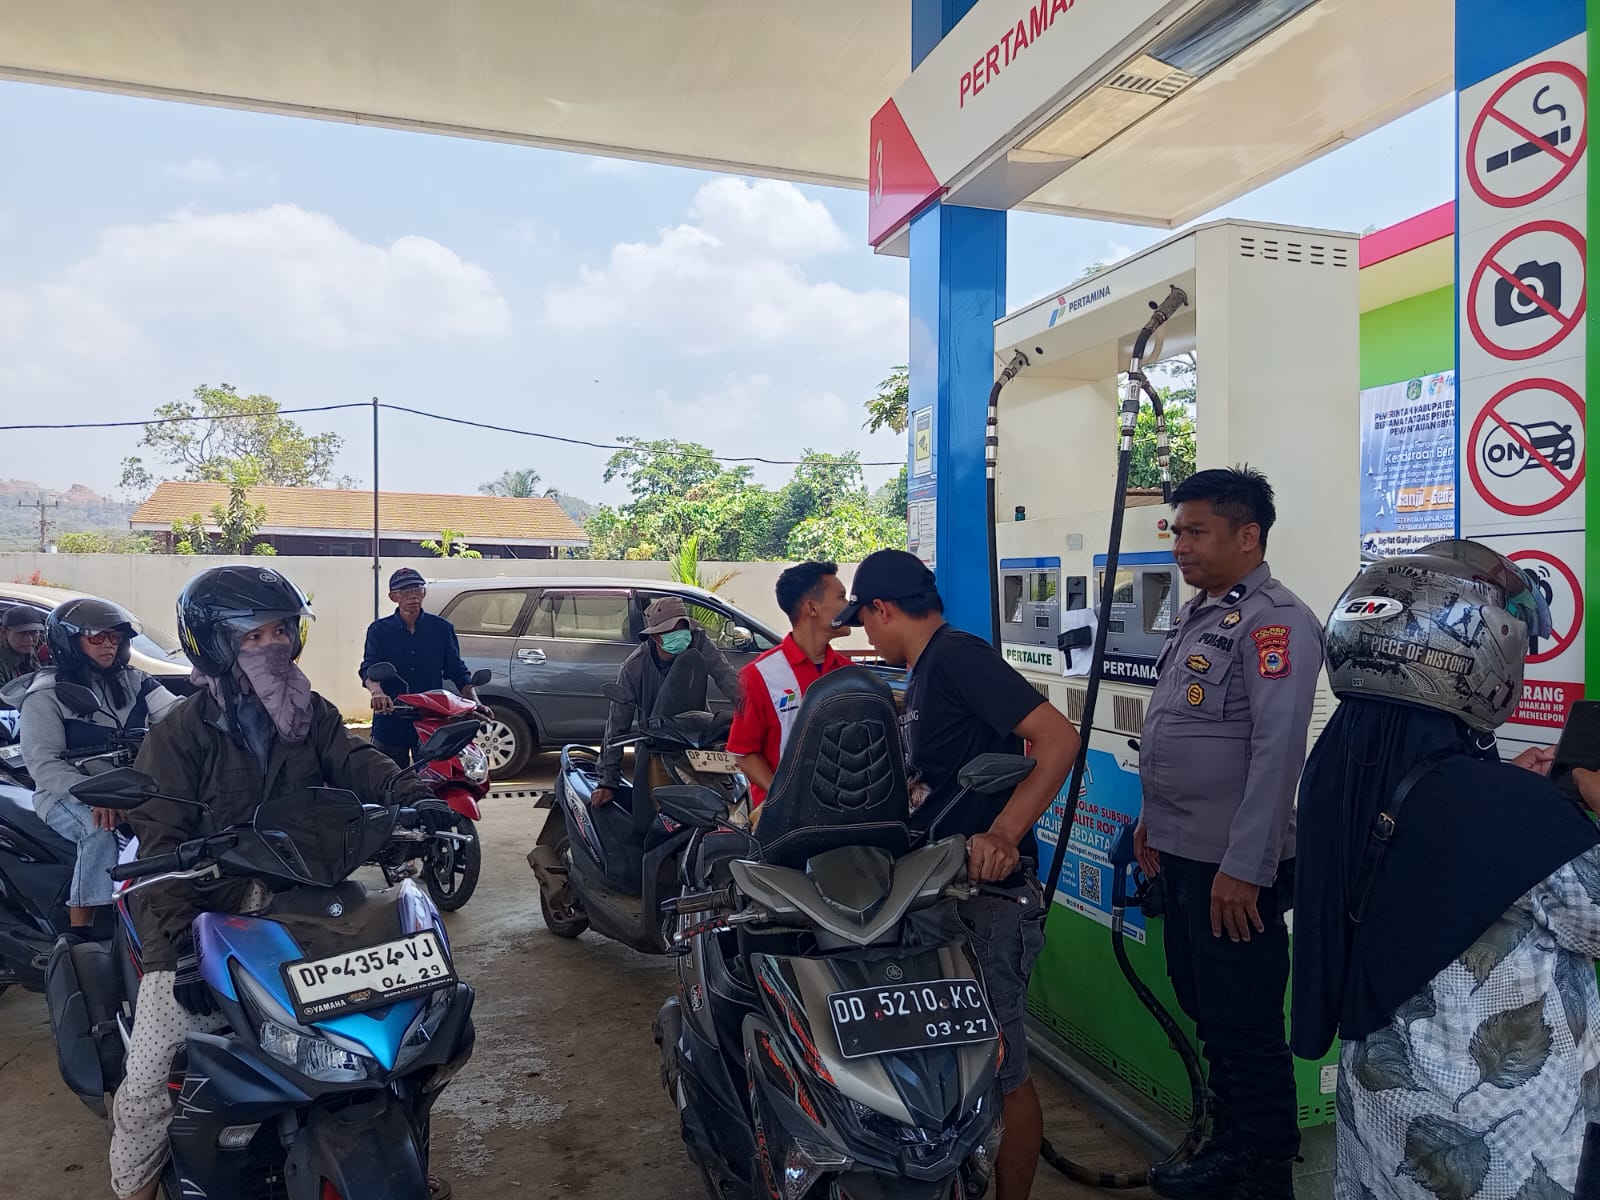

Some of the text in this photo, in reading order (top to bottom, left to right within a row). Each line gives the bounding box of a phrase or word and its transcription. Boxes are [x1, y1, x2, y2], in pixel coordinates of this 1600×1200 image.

[960, 0, 1076, 109] PERTAMA
[875, 138, 883, 208] 3
[1068, 285, 1111, 312] PERTAMINA
[1488, 442, 1524, 463] ON
[1345, 602, 1387, 614] GM
[1198, 632, 1234, 652] POLRI
[1006, 649, 1053, 666] PERTALITE
[1370, 635, 1402, 657] PIECE
[1405, 643, 1424, 661] OF
[1424, 647, 1473, 675] HISTORY
[1520, 686, 1564, 703] RANG
[1518, 710, 1564, 722] MENELEPON
[1553, 704, 1564, 712] HP
[688, 750, 729, 762] DP 2702
[1101, 807, 1133, 825] SUBSIDI
[299, 939, 434, 987] DP 4354 VJ
[312, 999, 347, 1014] YAMAHA
[834, 985, 981, 1024] DD 5210 KC
